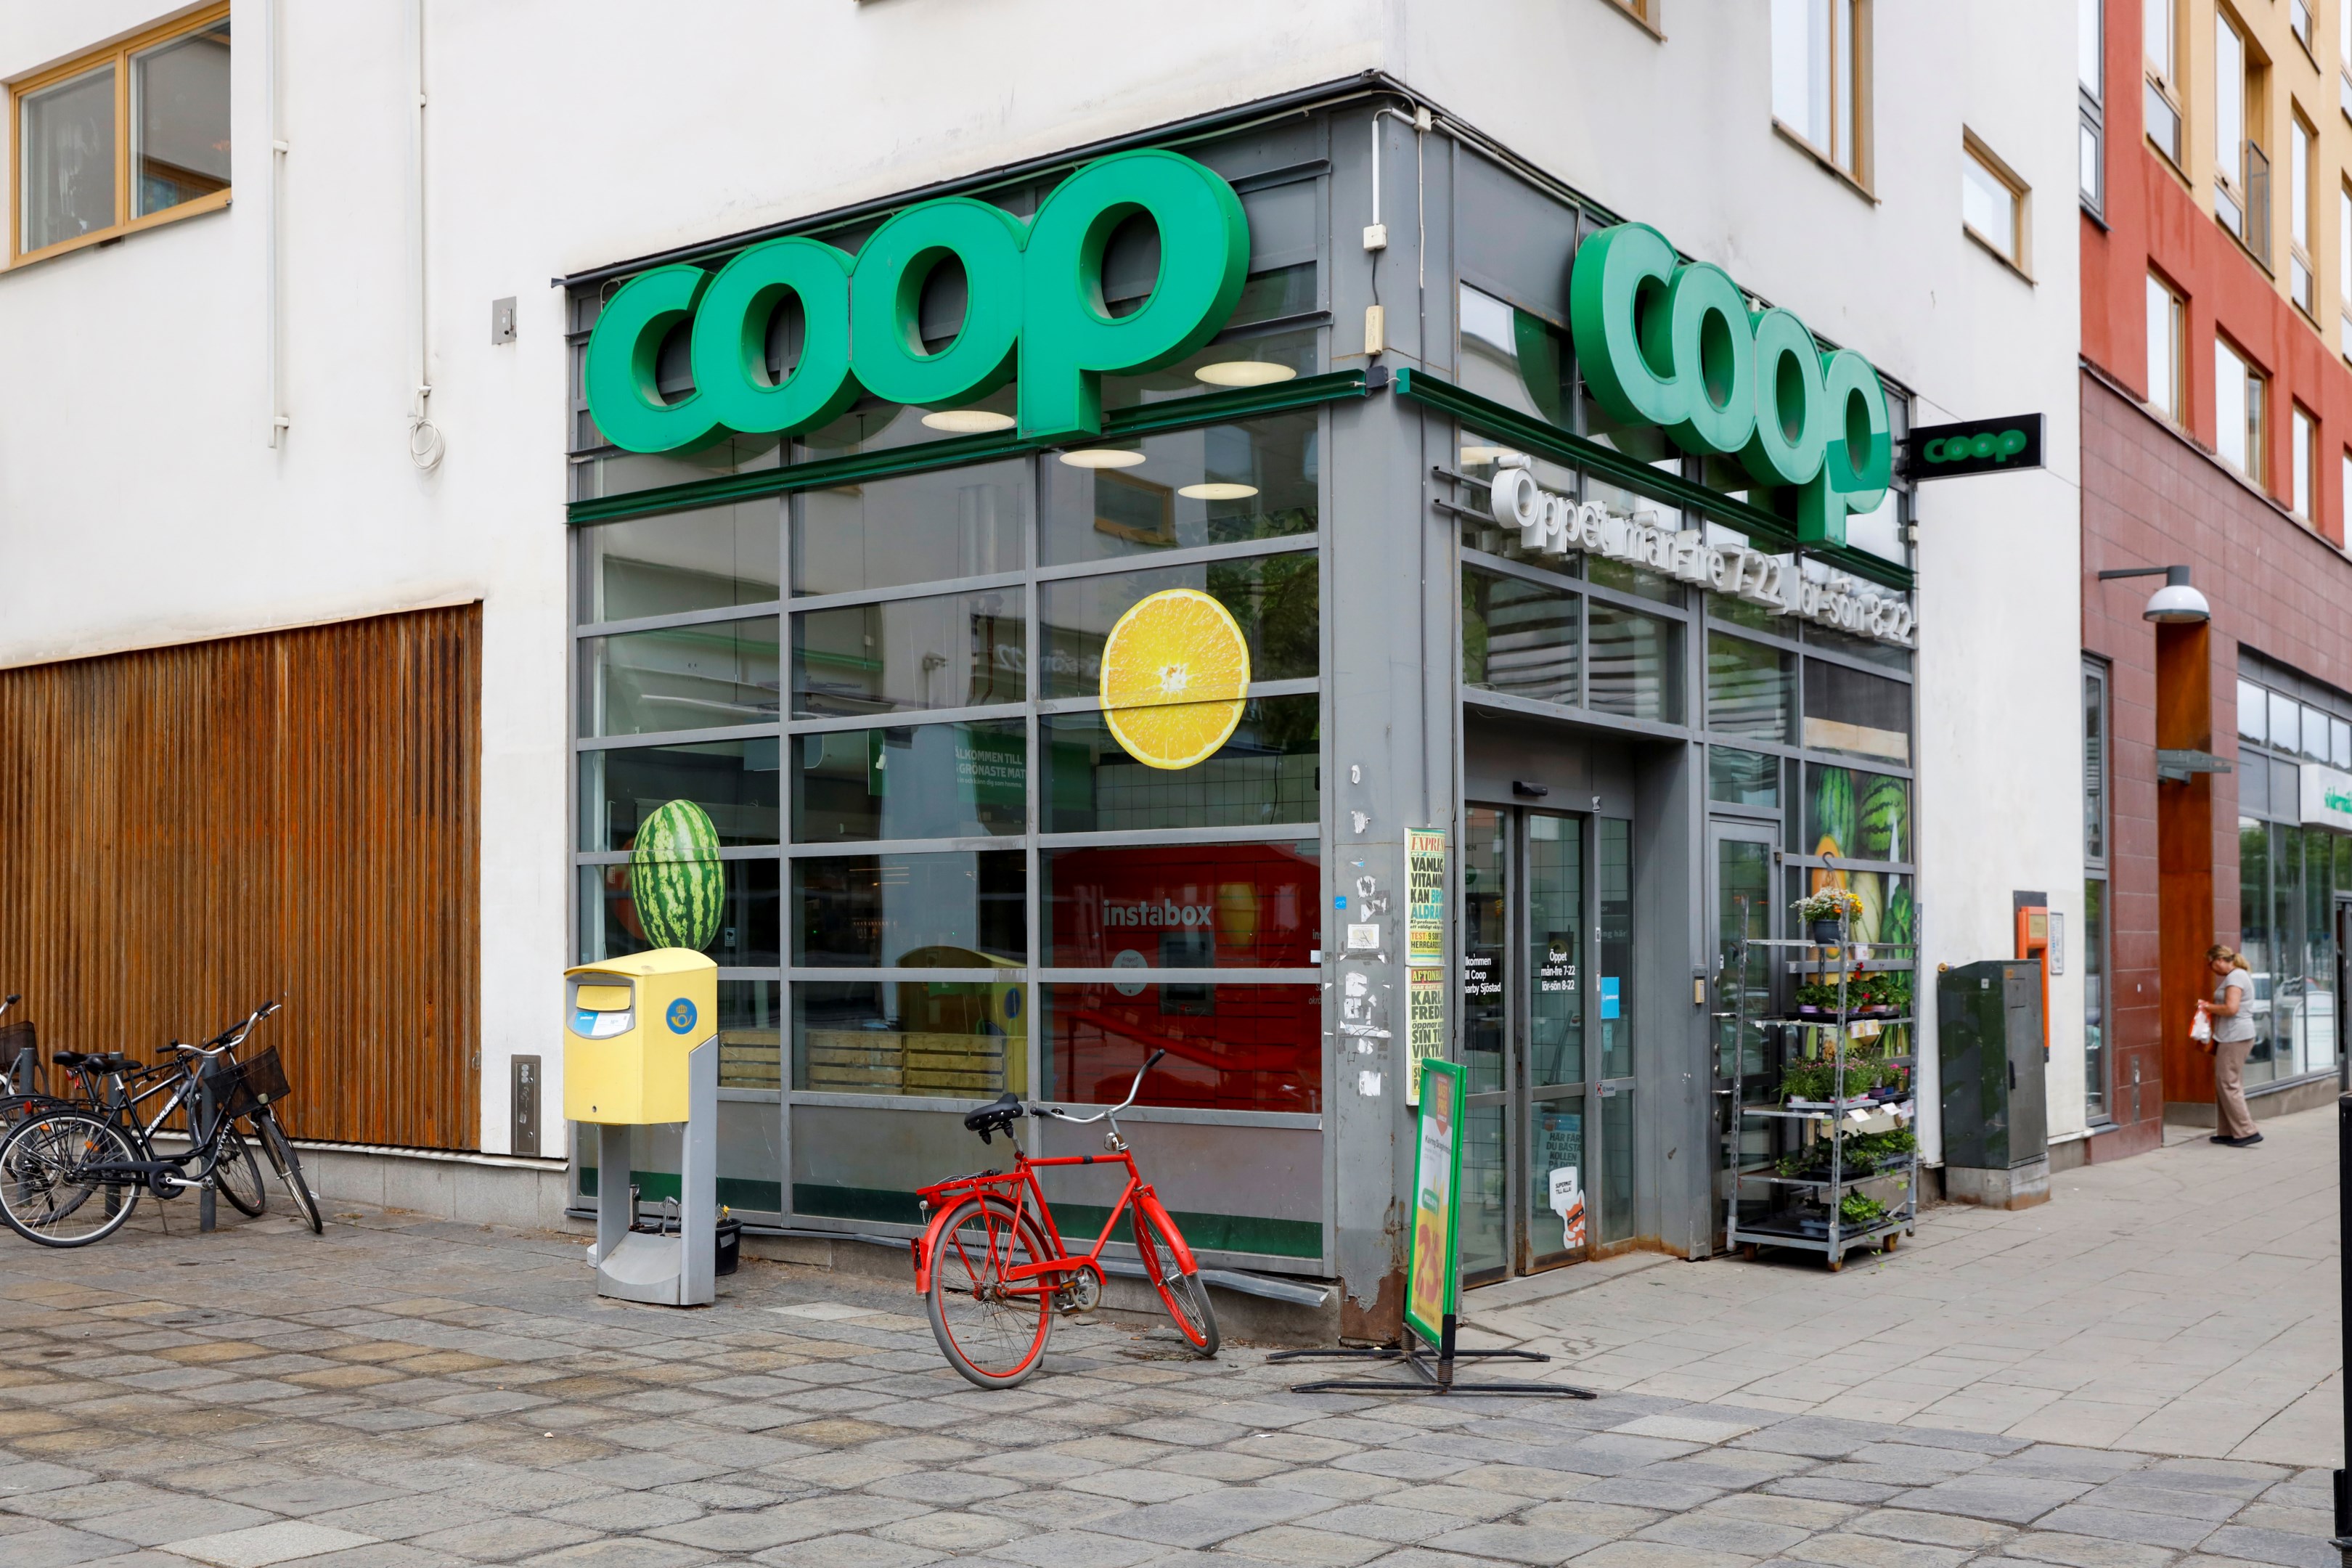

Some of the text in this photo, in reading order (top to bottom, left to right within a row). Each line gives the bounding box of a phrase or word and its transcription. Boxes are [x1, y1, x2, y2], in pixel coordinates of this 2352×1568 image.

[1491, 453, 1610, 555] Öppet
[1005, 753, 1022, 765] TILL
[959, 762, 1006, 777] GRÖNASTE
[1008, 768, 1026, 779] MAT
[1411, 836, 1445, 852] EXPRES
[1410, 857, 1443, 873] VANLIG
[1410, 889, 1429, 904] KAN
[1103, 898, 1212, 926] instabox
[1465, 956, 1491, 966] lkommen
[1549, 948, 1567, 964] Öppet
[1471, 970, 1487, 981] Coop
[1540, 965, 1575, 976] mån-fre 7-22
[1480, 982, 1500, 995] Sjöstad
[1542, 980, 1575, 991] lör-sön 8-22
[1411, 1005, 1443, 1020] FREDR
[1412, 1021, 1437, 1030] öppnar
[1412, 1029, 1431, 1044] SIN
[1412, 1043, 1444, 1058] VIKTKA
[1549, 1132, 1566, 1142] HÄR
[1546, 1142, 1557, 1151] DU
[1549, 1151, 1577, 1161] KOLLEN
